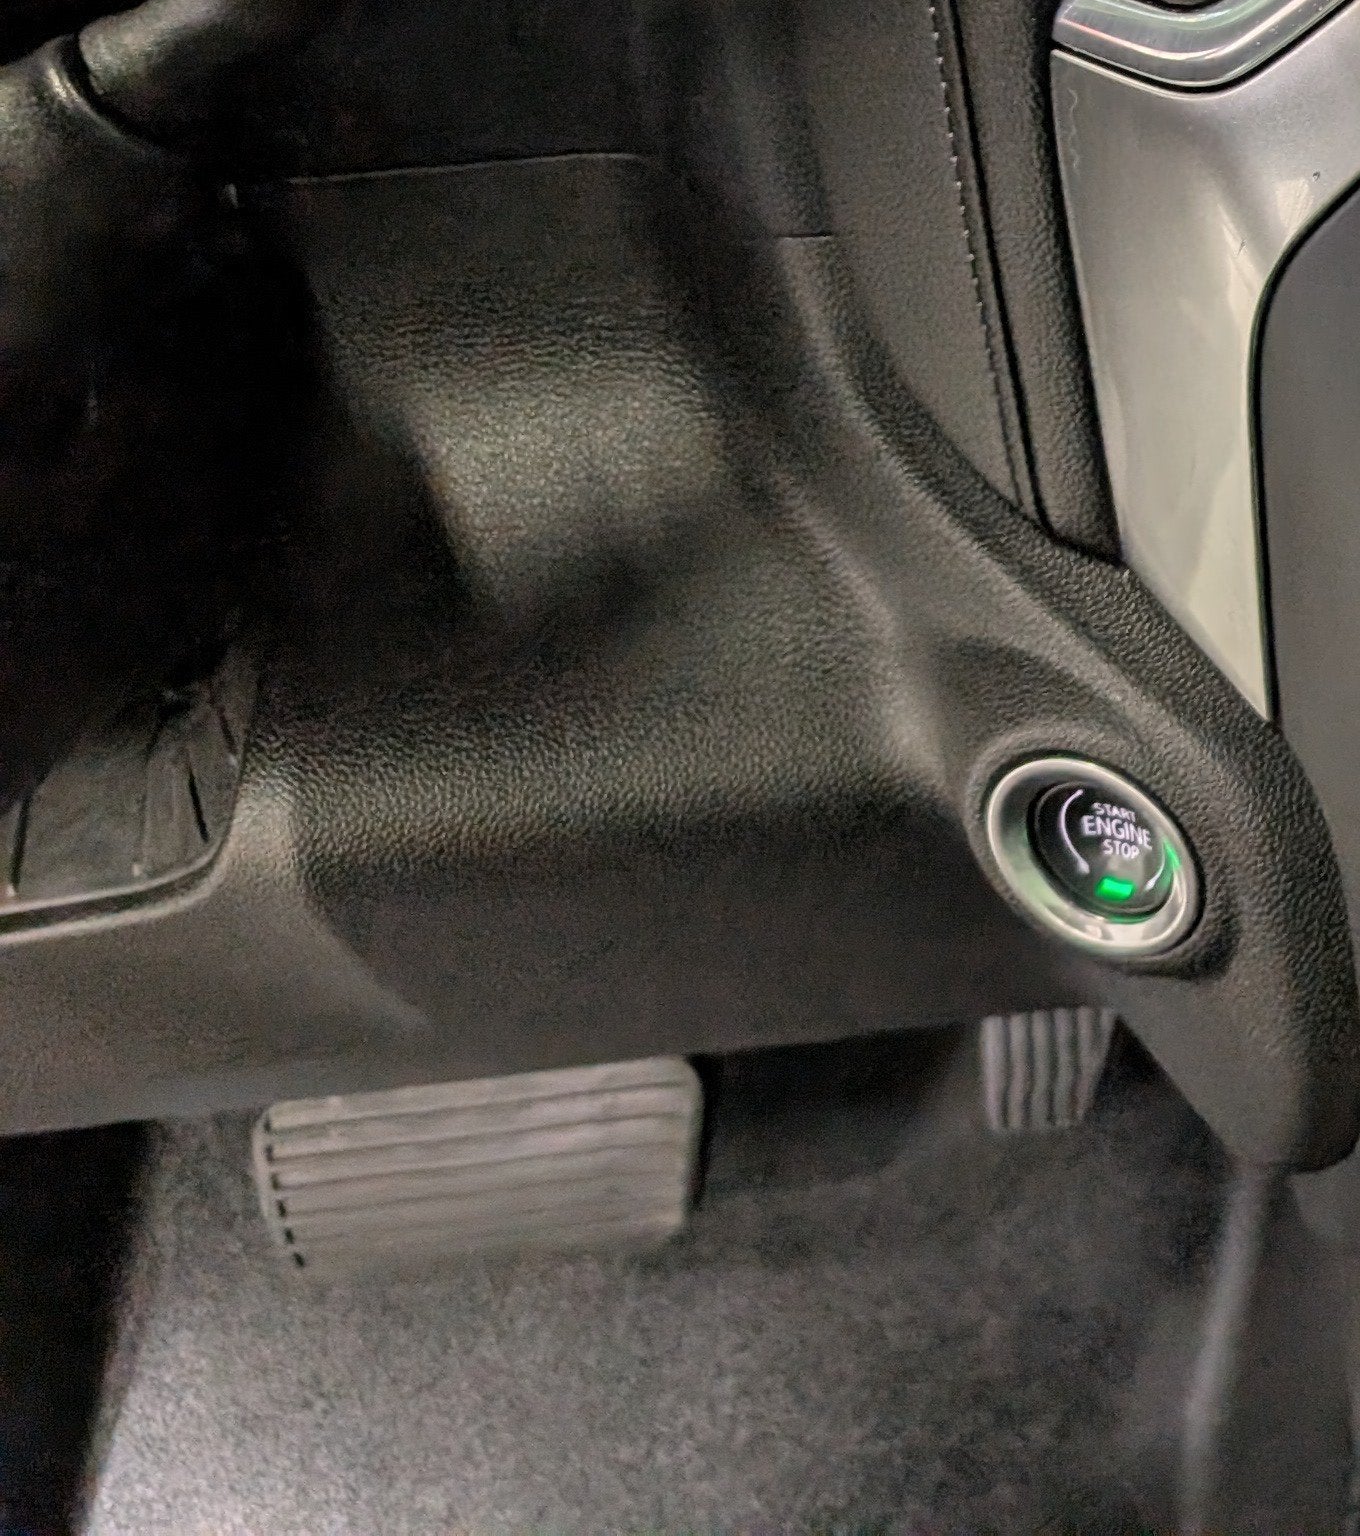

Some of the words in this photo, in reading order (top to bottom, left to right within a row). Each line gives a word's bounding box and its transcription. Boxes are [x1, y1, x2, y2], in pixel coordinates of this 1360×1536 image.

[1091, 802, 1136, 822] START
[1081, 815, 1153, 850] ENGINE
[1102, 838, 1140, 860] STOP
